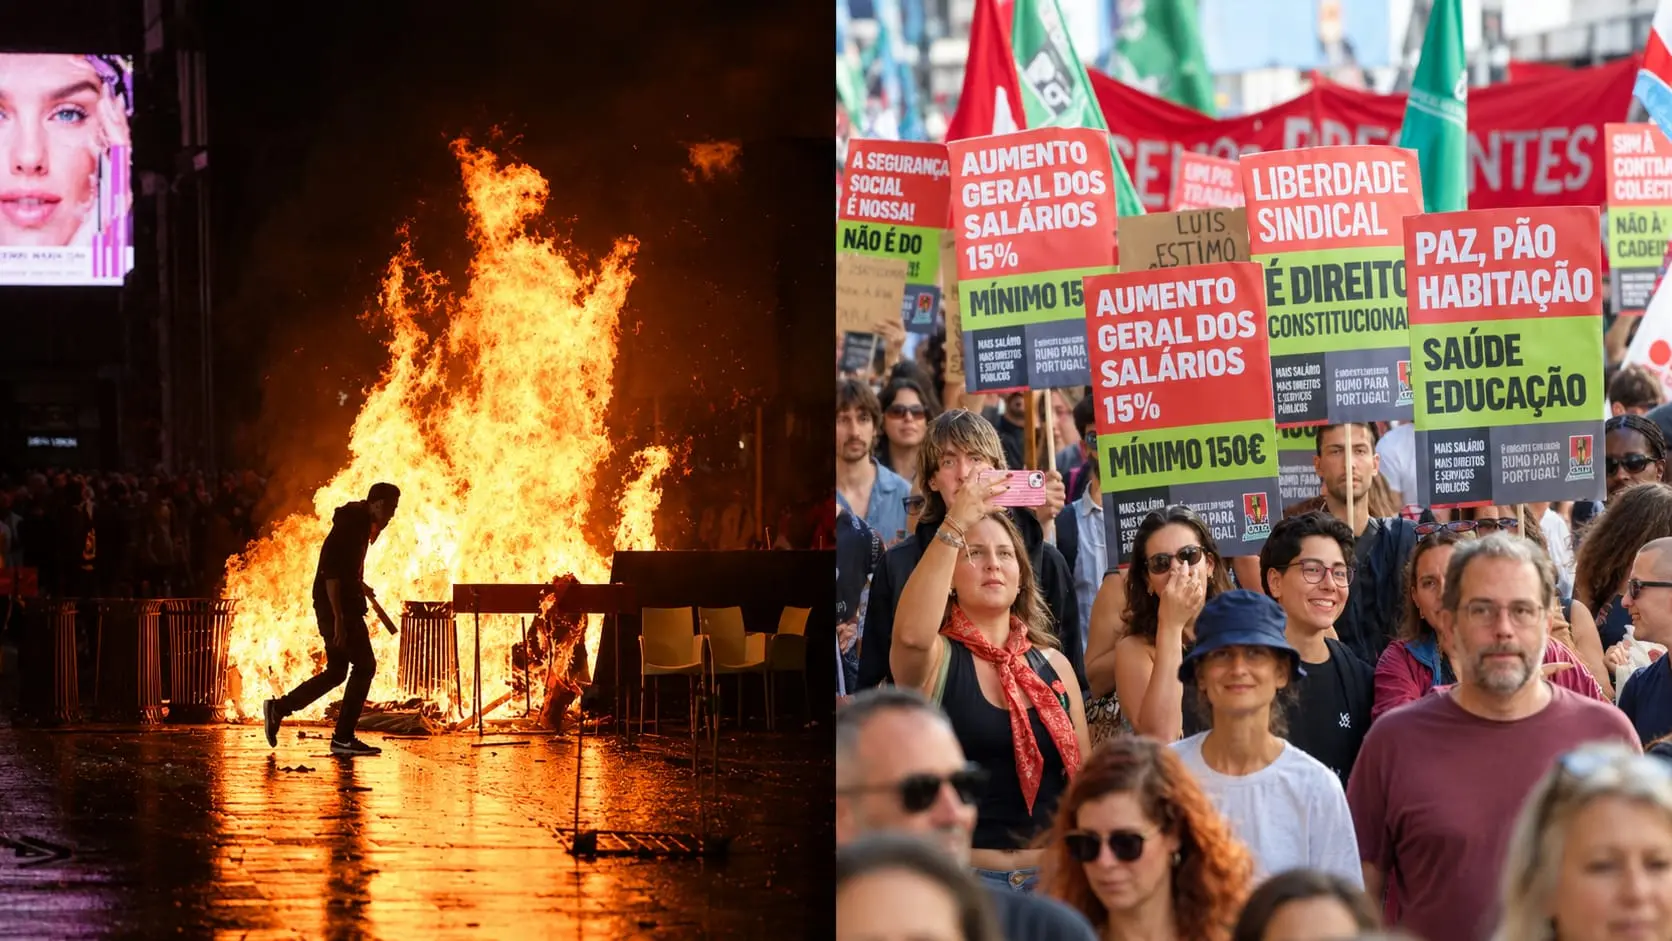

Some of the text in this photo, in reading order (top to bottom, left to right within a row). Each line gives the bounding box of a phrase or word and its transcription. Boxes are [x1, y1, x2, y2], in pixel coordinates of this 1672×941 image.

[852, 151, 950, 180] A SEGURANÇA
[961, 140, 1088, 177] AUMENTO
[850, 174, 903, 197] SOCIAL
[962, 174, 1051, 208] GERAL
[1053, 170, 1106, 197] DOS
[1252, 160, 1409, 201] LIBERDADE
[847, 194, 915, 222] É NOSSA!
[964, 201, 1098, 240] SALÁRIOS
[1257, 201, 1389, 243] SINDICAL
[1616, 212, 1647, 234] NÃO
[844, 225, 922, 255] NÃO É DO
[1416, 216, 1556, 268] PAZ, PÃO
[965, 241, 1019, 271] 15%
[1096, 276, 1236, 317] AUMENTO
[1265, 257, 1286, 307] É
[1418, 260, 1593, 313] HABITAÇÃO
[969, 281, 1057, 317] MÍNIMO
[977, 339, 994, 350] MAIS
[1097, 310, 1257, 352] GERAL DOS
[1060, 344, 1087, 357] PARA
[1423, 327, 1523, 372] SAÚDE
[1100, 346, 1246, 388] SALÁRIOS
[1275, 366, 1292, 378] MAIS
[1335, 376, 1389, 392] RUMO PARA
[1425, 366, 1587, 417] EDUCAÇÃO
[1103, 391, 1160, 424] 15%
[1108, 433, 1267, 478] MÍNIMO 150€
[1434, 442, 1453, 454] MAIS
[1453, 437, 1485, 453] SALÁRIO
[1502, 452, 1560, 469] RUMO PARA
[1434, 455, 1485, 469] MAIS DIREITOS
[1435, 470, 1440, 481] E
[1502, 466, 1560, 484] PORTUGAL!
[1118, 502, 1135, 515] MAIS
[1120, 516, 1136, 529] MAIS
[1209, 510, 1236, 525] PARA
